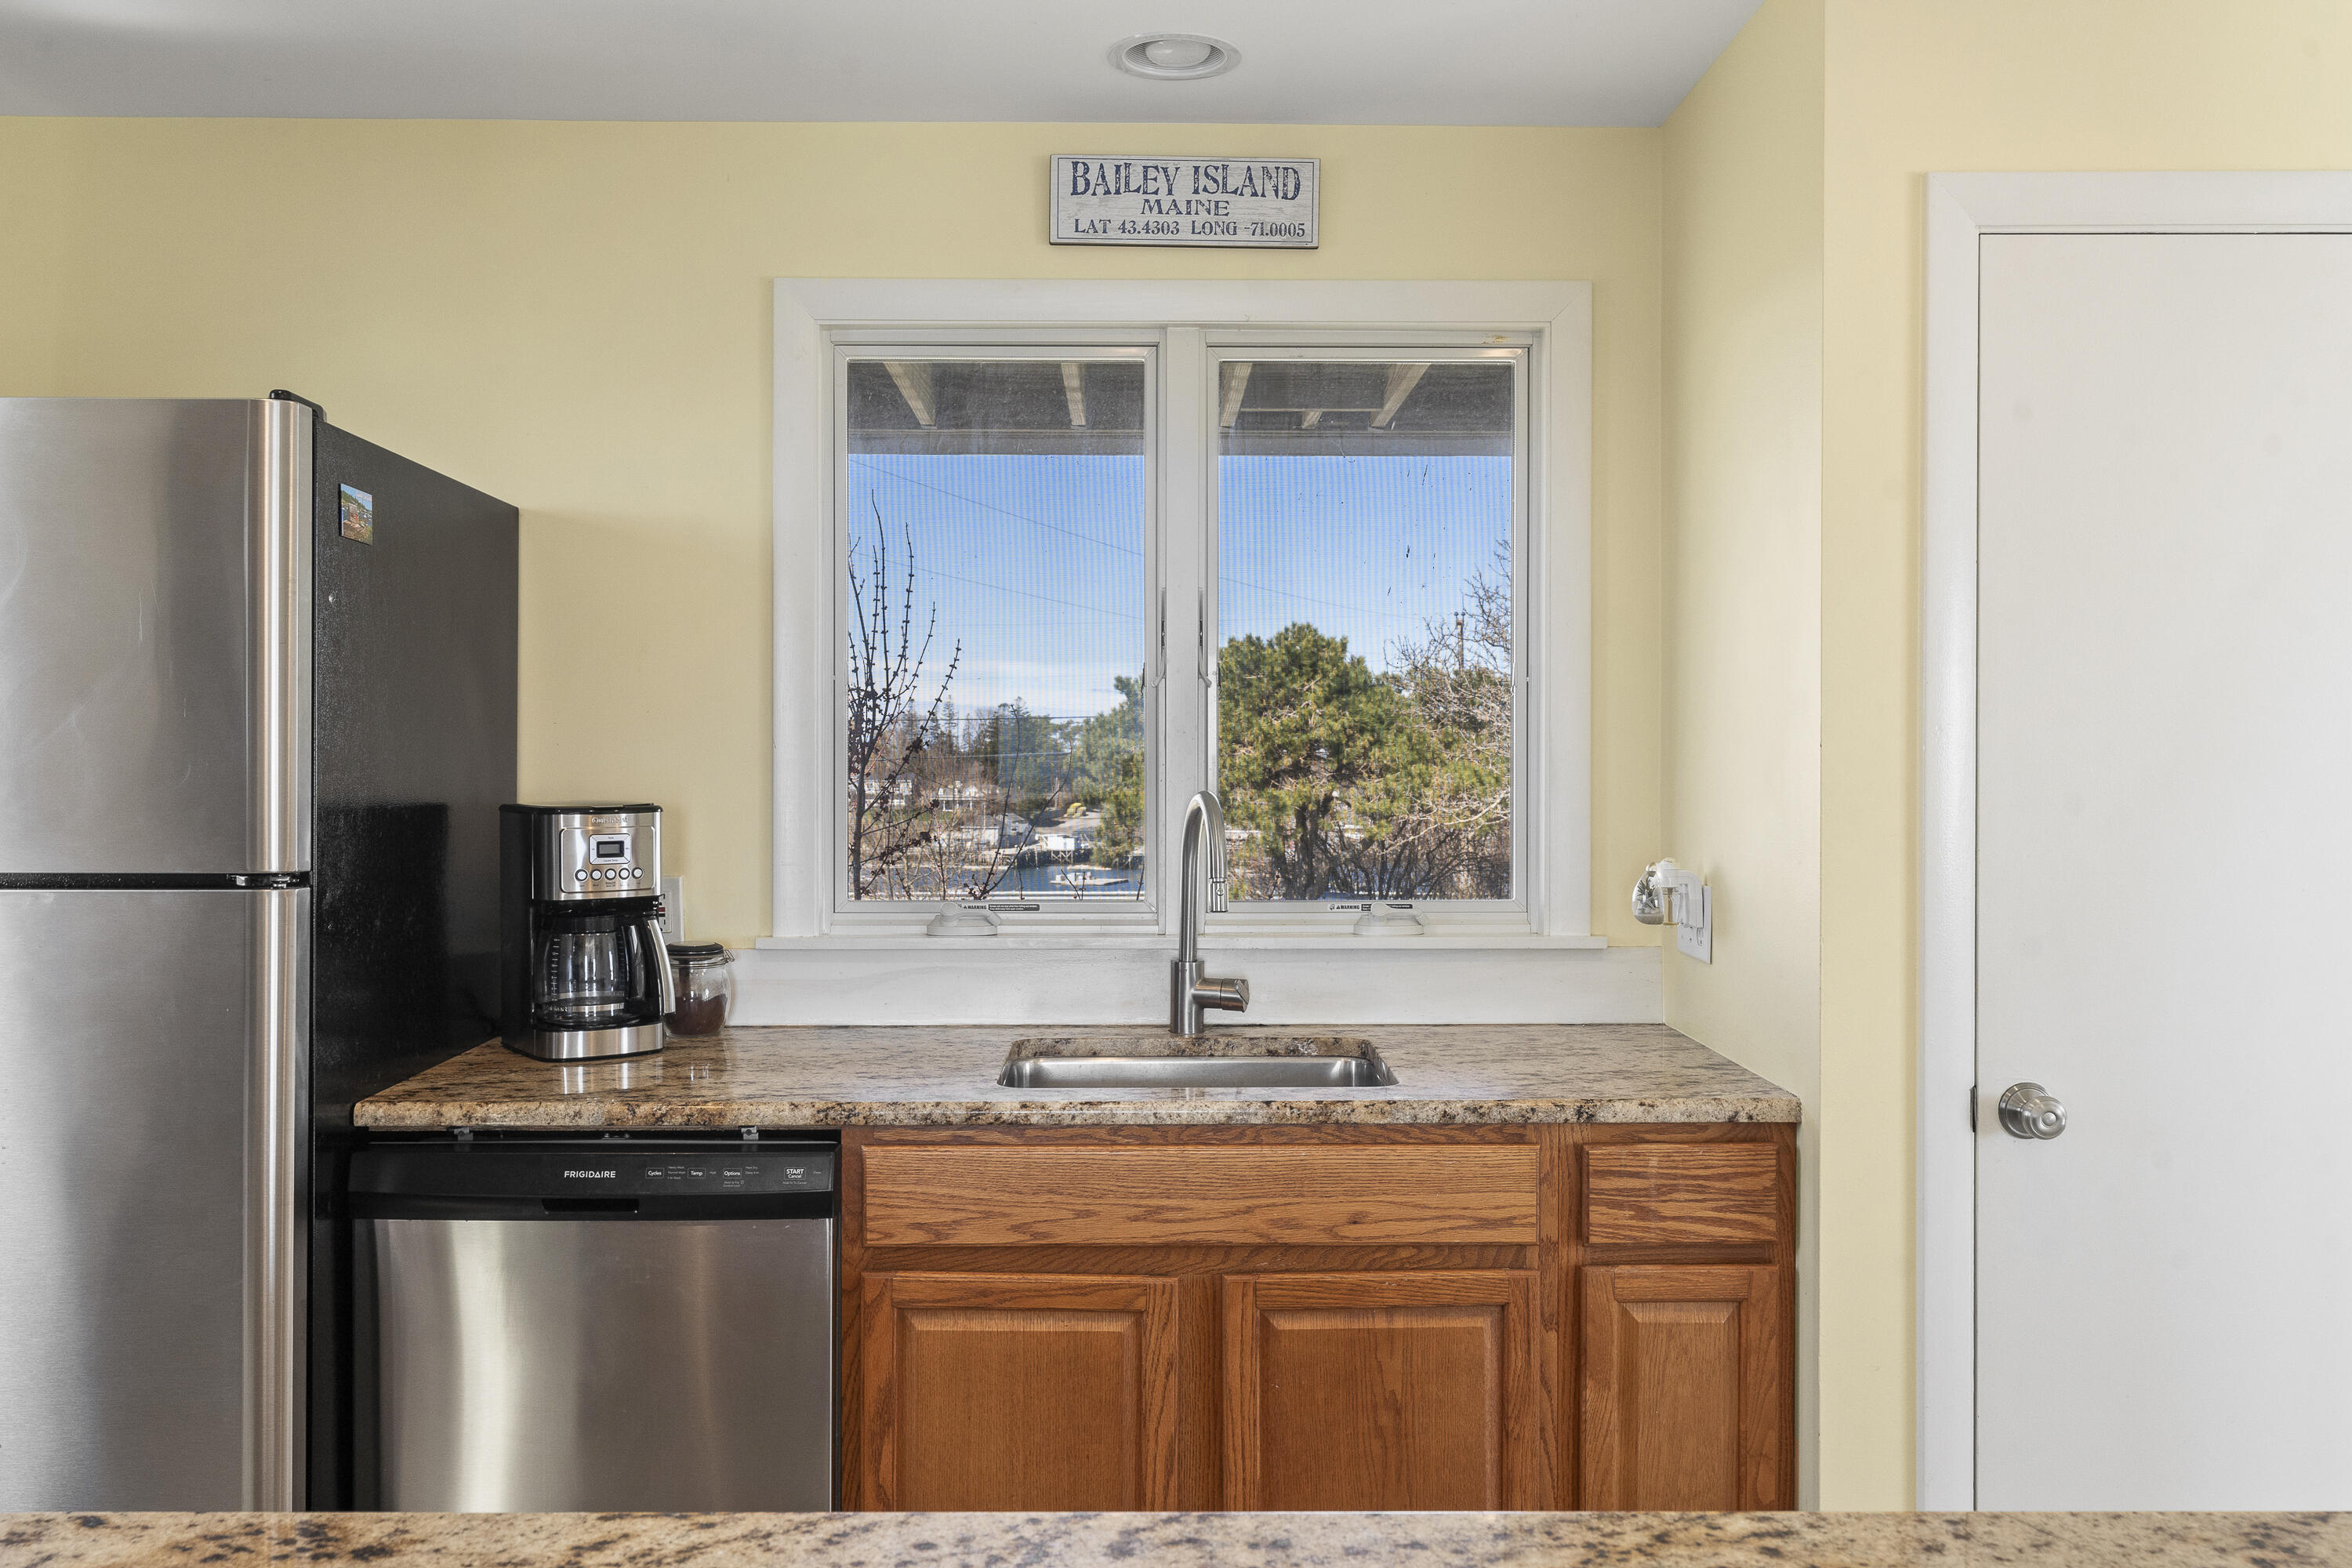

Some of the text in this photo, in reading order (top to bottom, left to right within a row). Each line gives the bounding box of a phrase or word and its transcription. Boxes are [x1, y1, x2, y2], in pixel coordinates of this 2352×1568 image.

[1070, 161, 1301, 201] BAILEY ISLAND
[1140, 198, 1230, 216] MAINE
[1074, 218, 1305, 238] LAT 43.4303 LONG -71.0005
